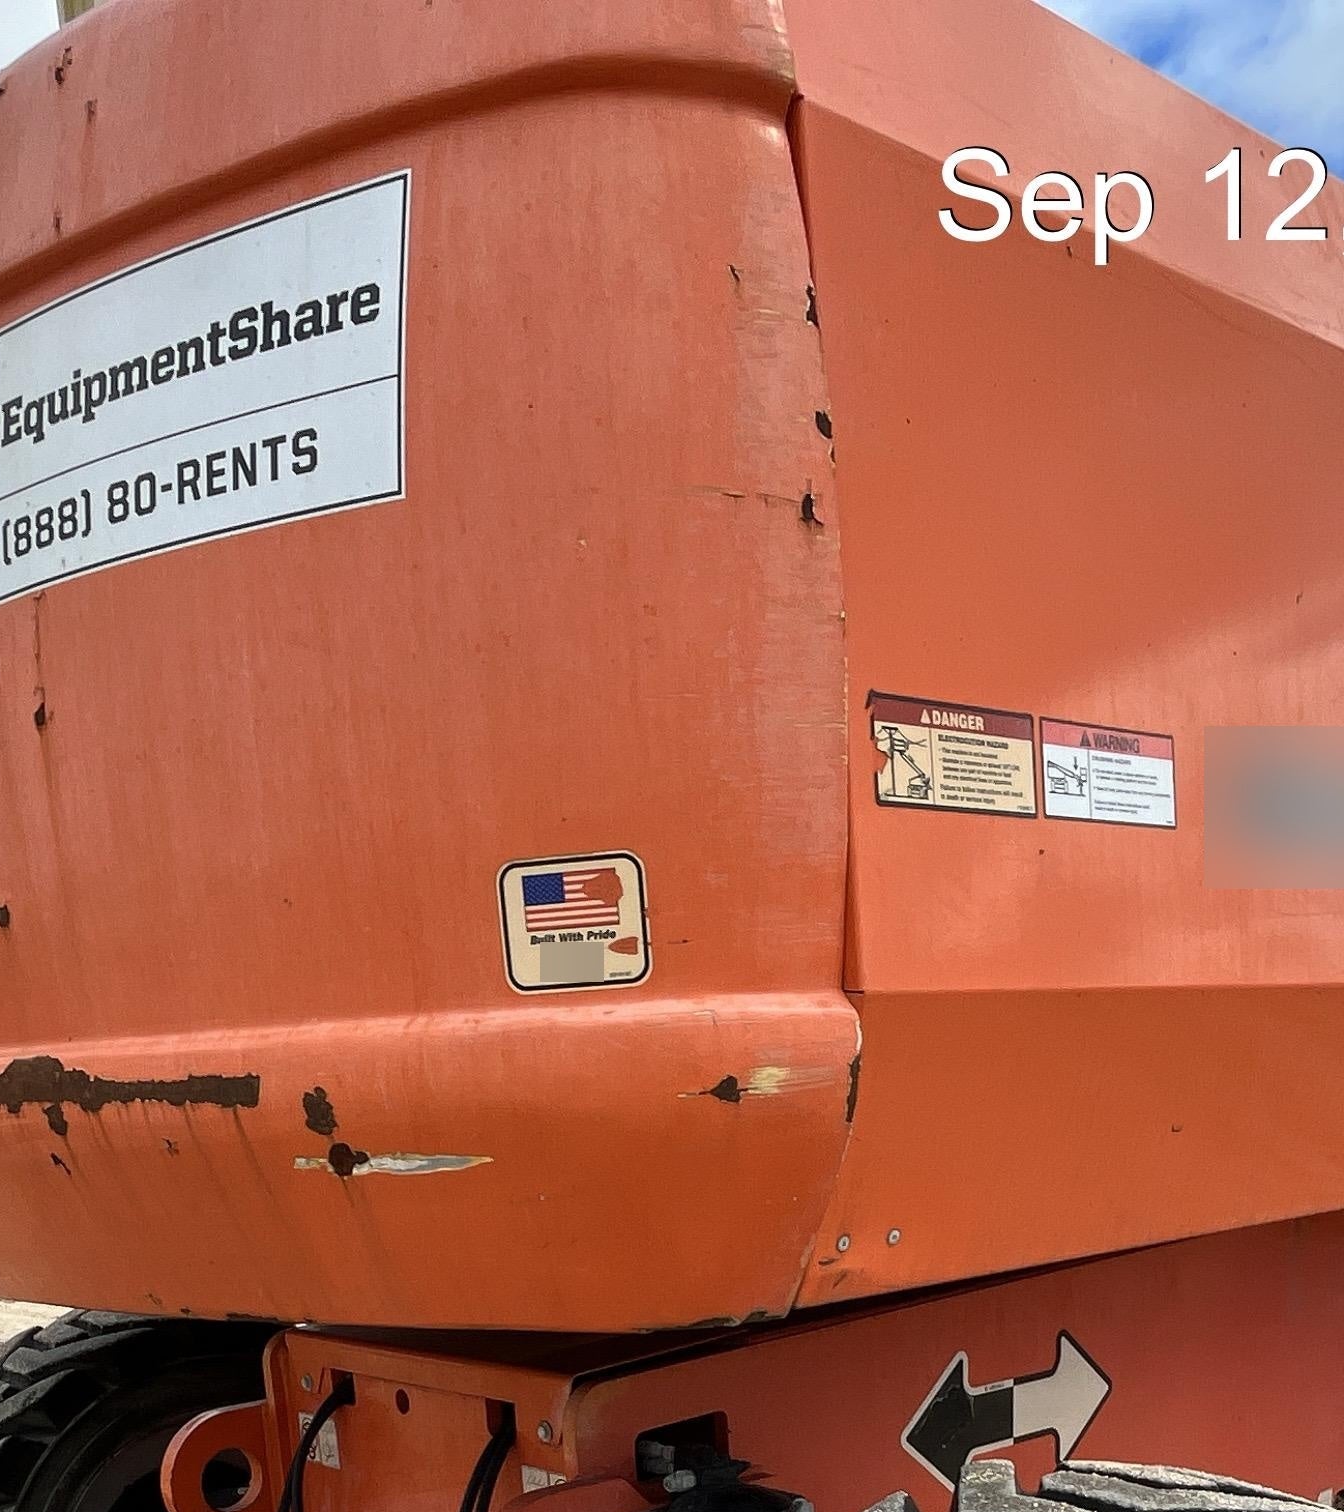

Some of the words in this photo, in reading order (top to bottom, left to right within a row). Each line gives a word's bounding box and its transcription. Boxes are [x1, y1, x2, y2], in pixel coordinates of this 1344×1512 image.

[0, 280, 381, 447] EquipmentShare
[1, 490, 92, 566] (888)
[106, 426, 319, 525] 80-RENTS
[931, 708, 986, 731] DANGER
[1092, 731, 1141, 754] WARNING
[559, 931, 584, 943] With
[587, 928, 617, 941] Pride
